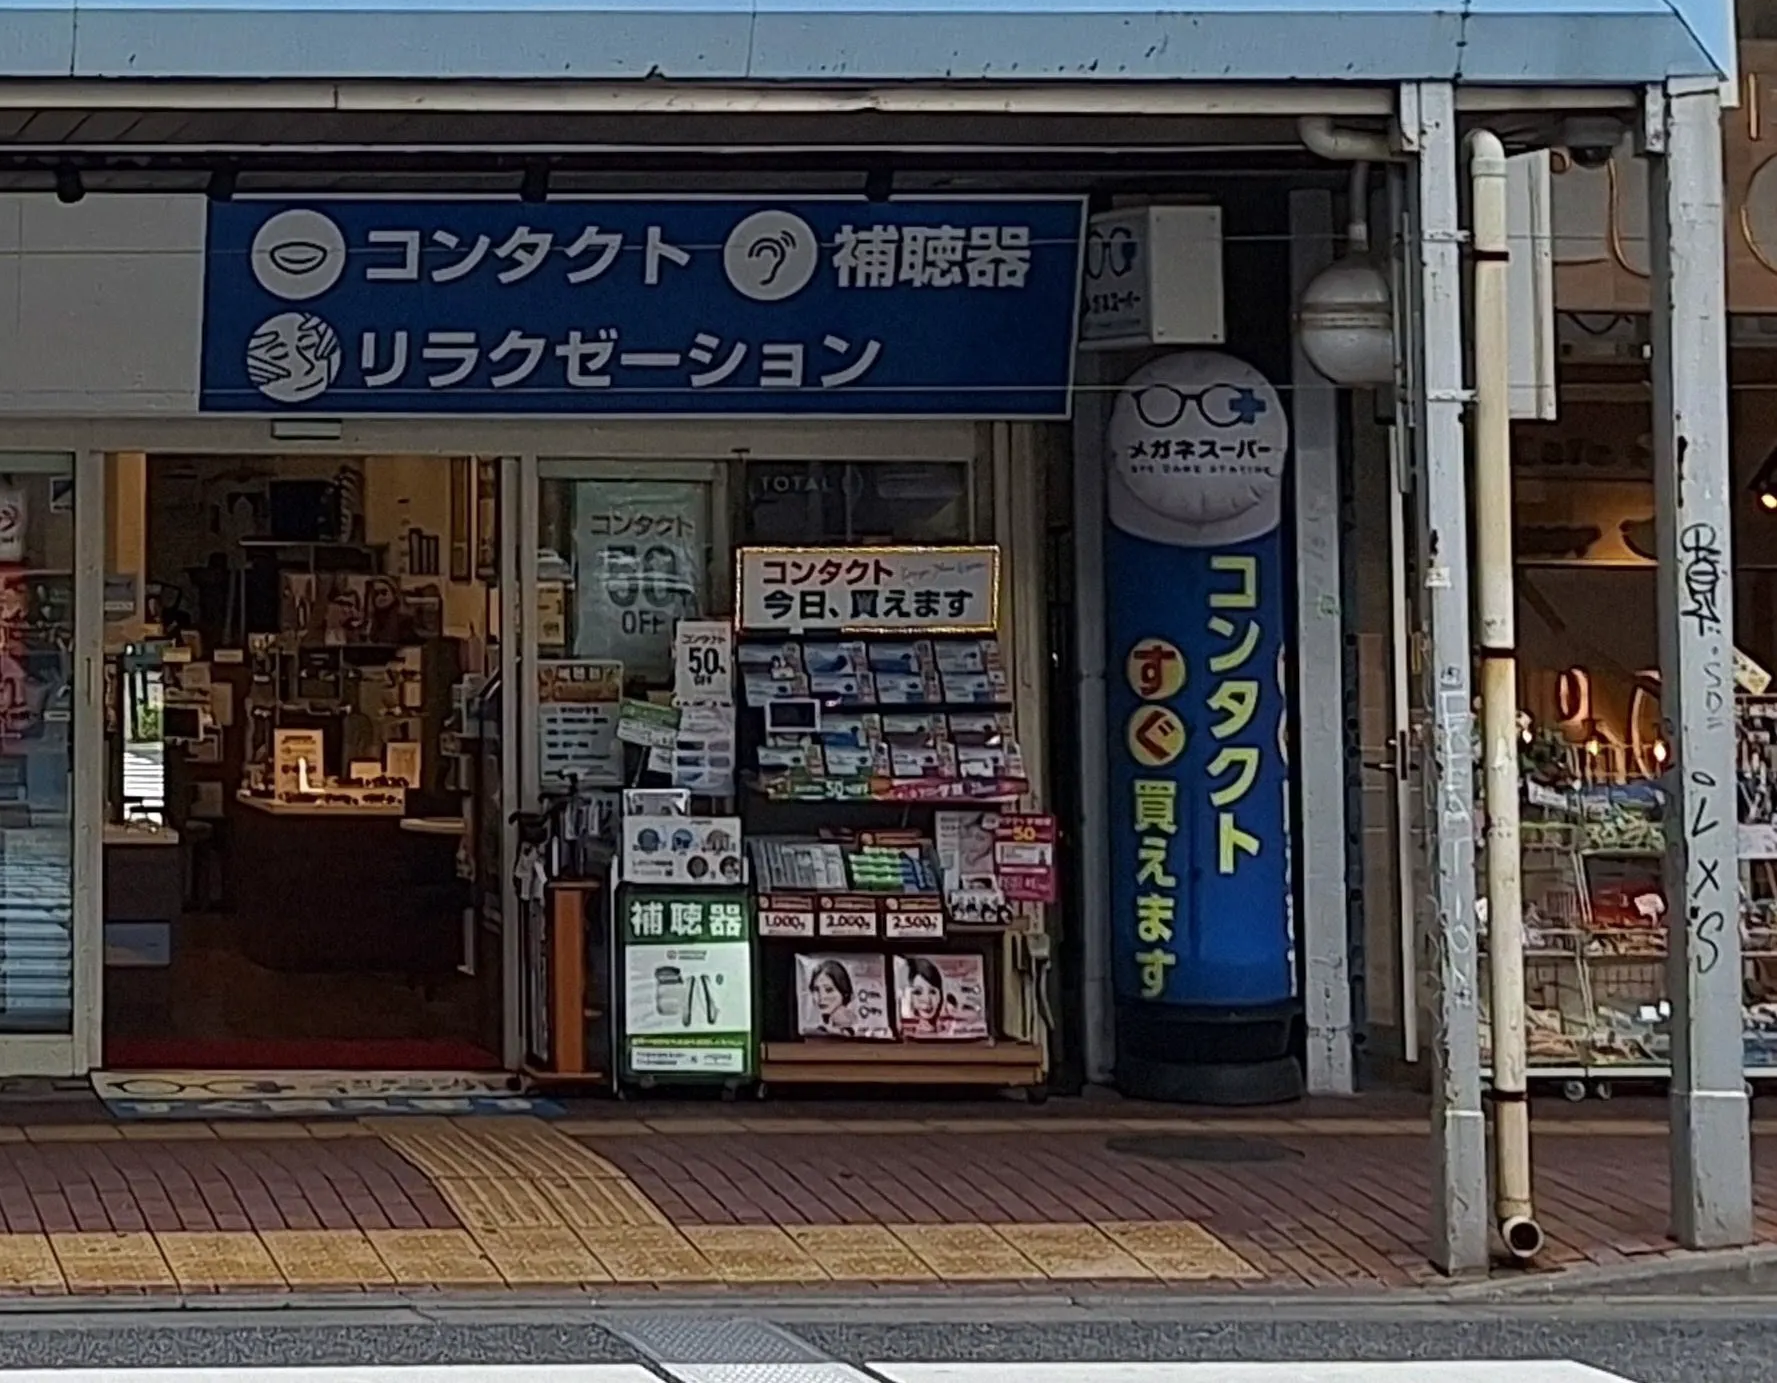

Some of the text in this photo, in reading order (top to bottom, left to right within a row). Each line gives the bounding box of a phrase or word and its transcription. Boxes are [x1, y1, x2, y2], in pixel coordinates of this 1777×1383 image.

[365, 224, 1032, 289] コンタクト 補聴器
[361, 327, 881, 390] リラクゼーション
[1129, 439, 1272, 461] メガネスーパー
[762, 559, 894, 586] コンタクト
[762, 589, 974, 619] 今日、買えます
[1205, 555, 1261, 875] コンタクト
[1132, 644, 1178, 999] すぐ買えます
[630, 900, 743, 938] 補聴器
